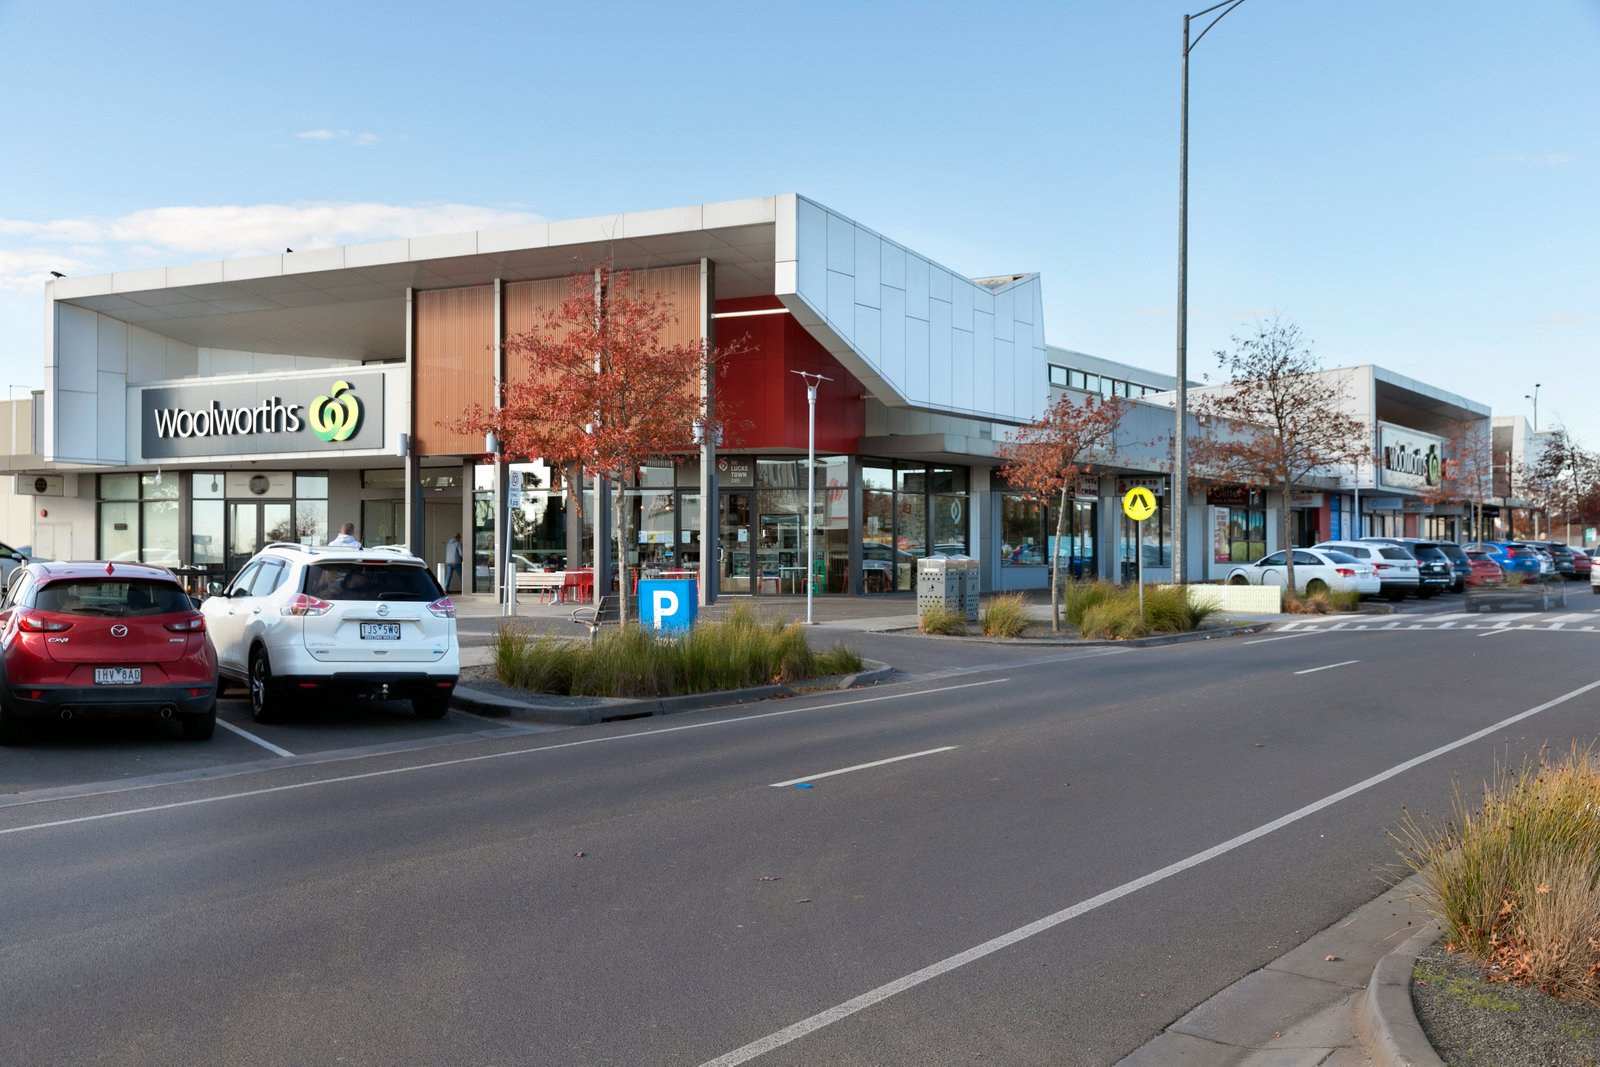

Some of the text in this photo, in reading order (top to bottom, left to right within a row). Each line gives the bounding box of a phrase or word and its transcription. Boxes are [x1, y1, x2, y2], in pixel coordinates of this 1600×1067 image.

[154, 395, 300, 438] Woolworths
[653, 590, 679, 629] P
[97, 669, 115, 680] 1HV
